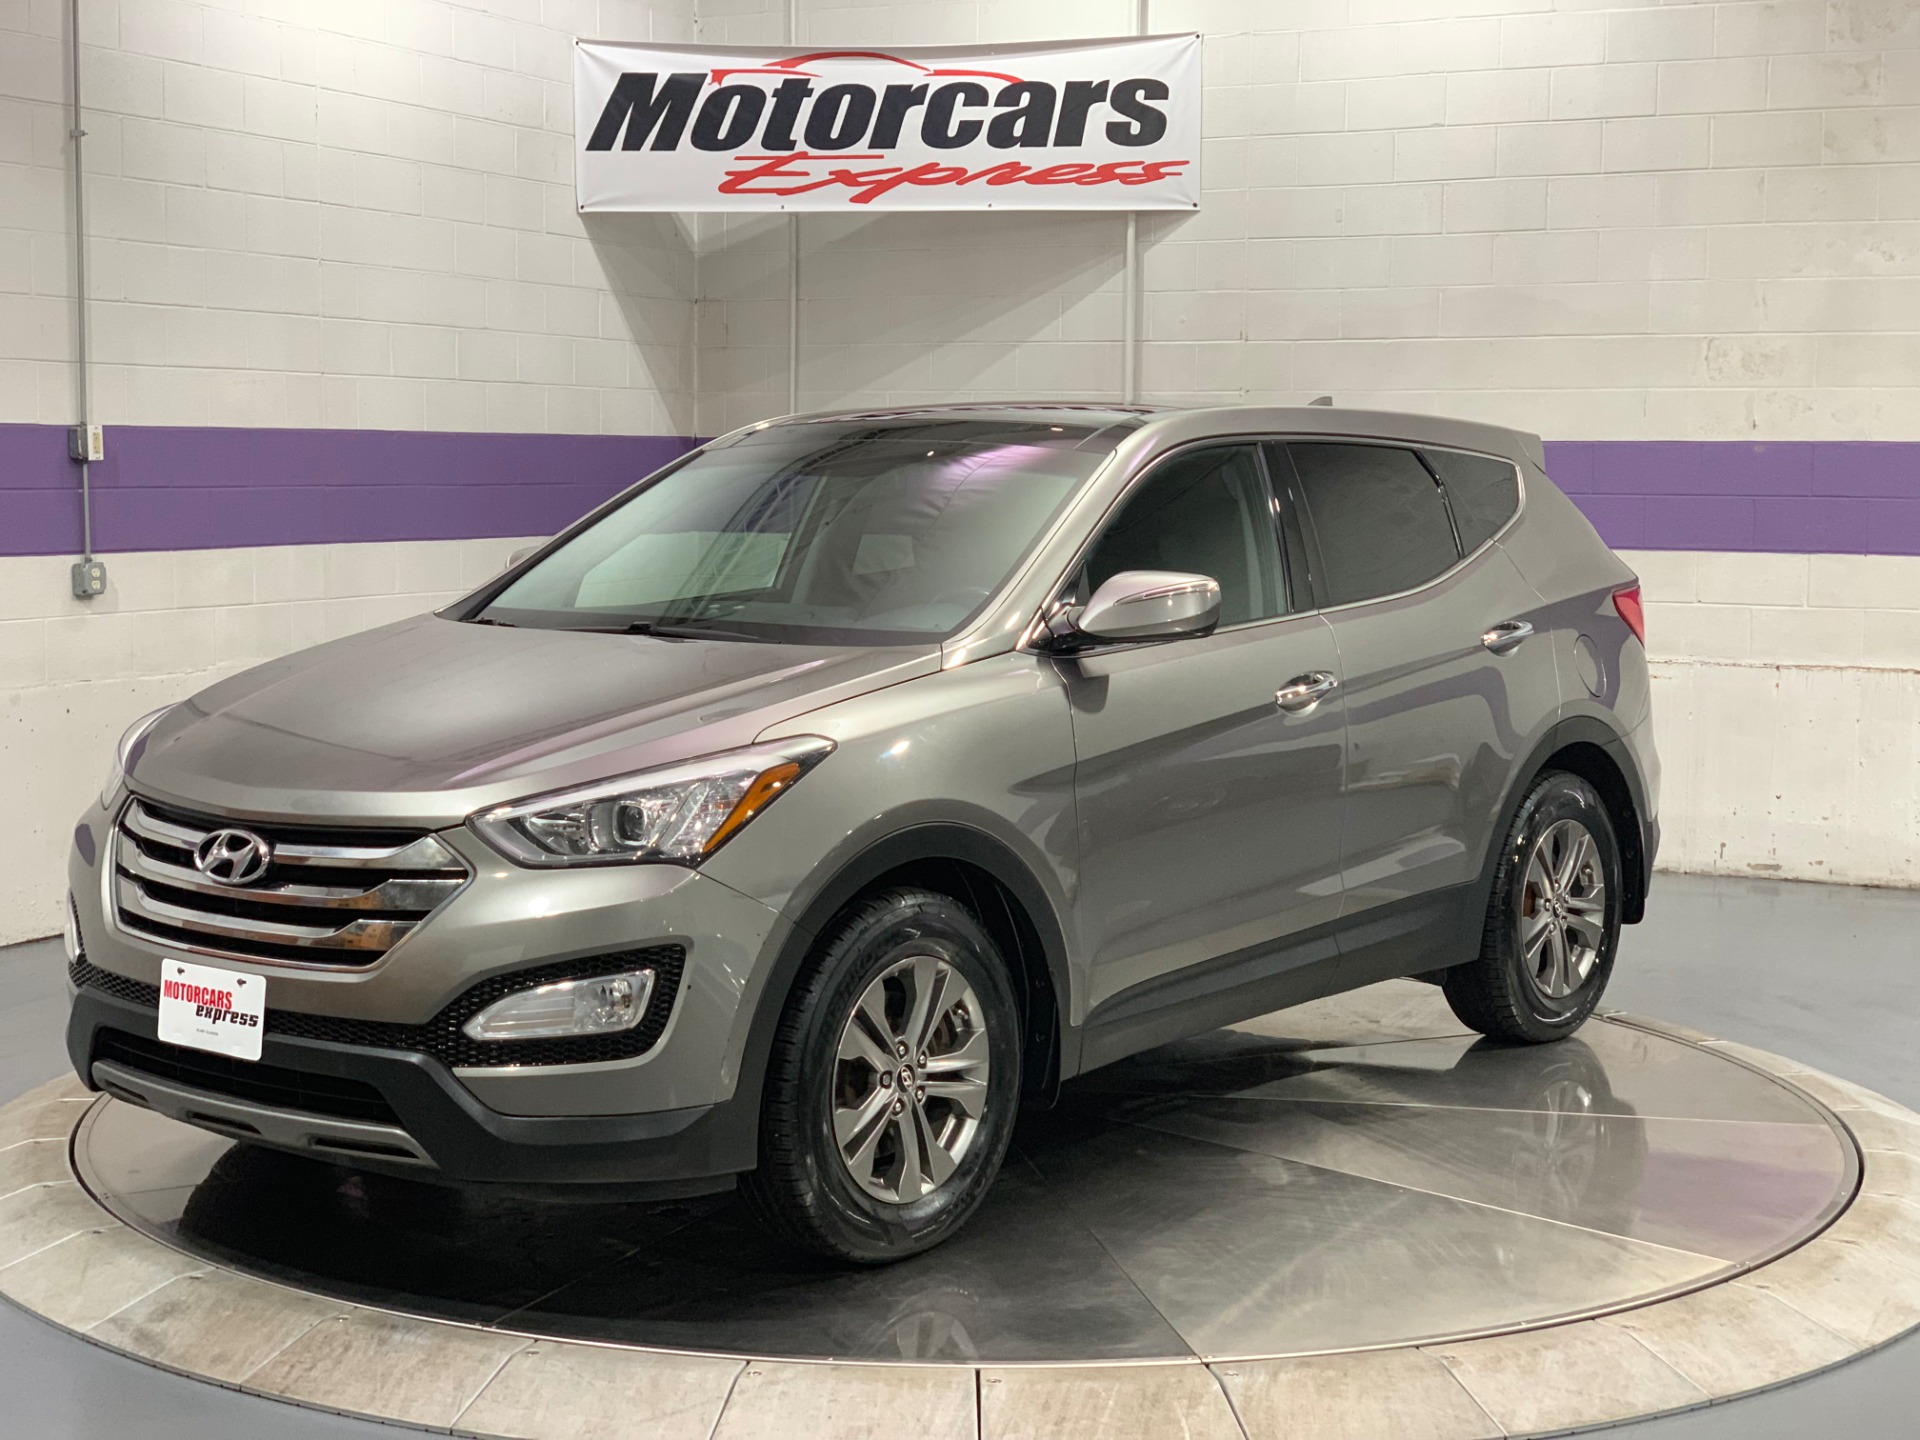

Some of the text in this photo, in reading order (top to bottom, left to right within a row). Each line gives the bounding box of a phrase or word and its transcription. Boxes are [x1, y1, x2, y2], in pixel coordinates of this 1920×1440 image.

[585, 71, 1169, 152] Motorcars
[717, 150, 1191, 205] Express
[163, 979, 233, 1011] MOTORCARS
[195, 1004, 259, 1028] express
